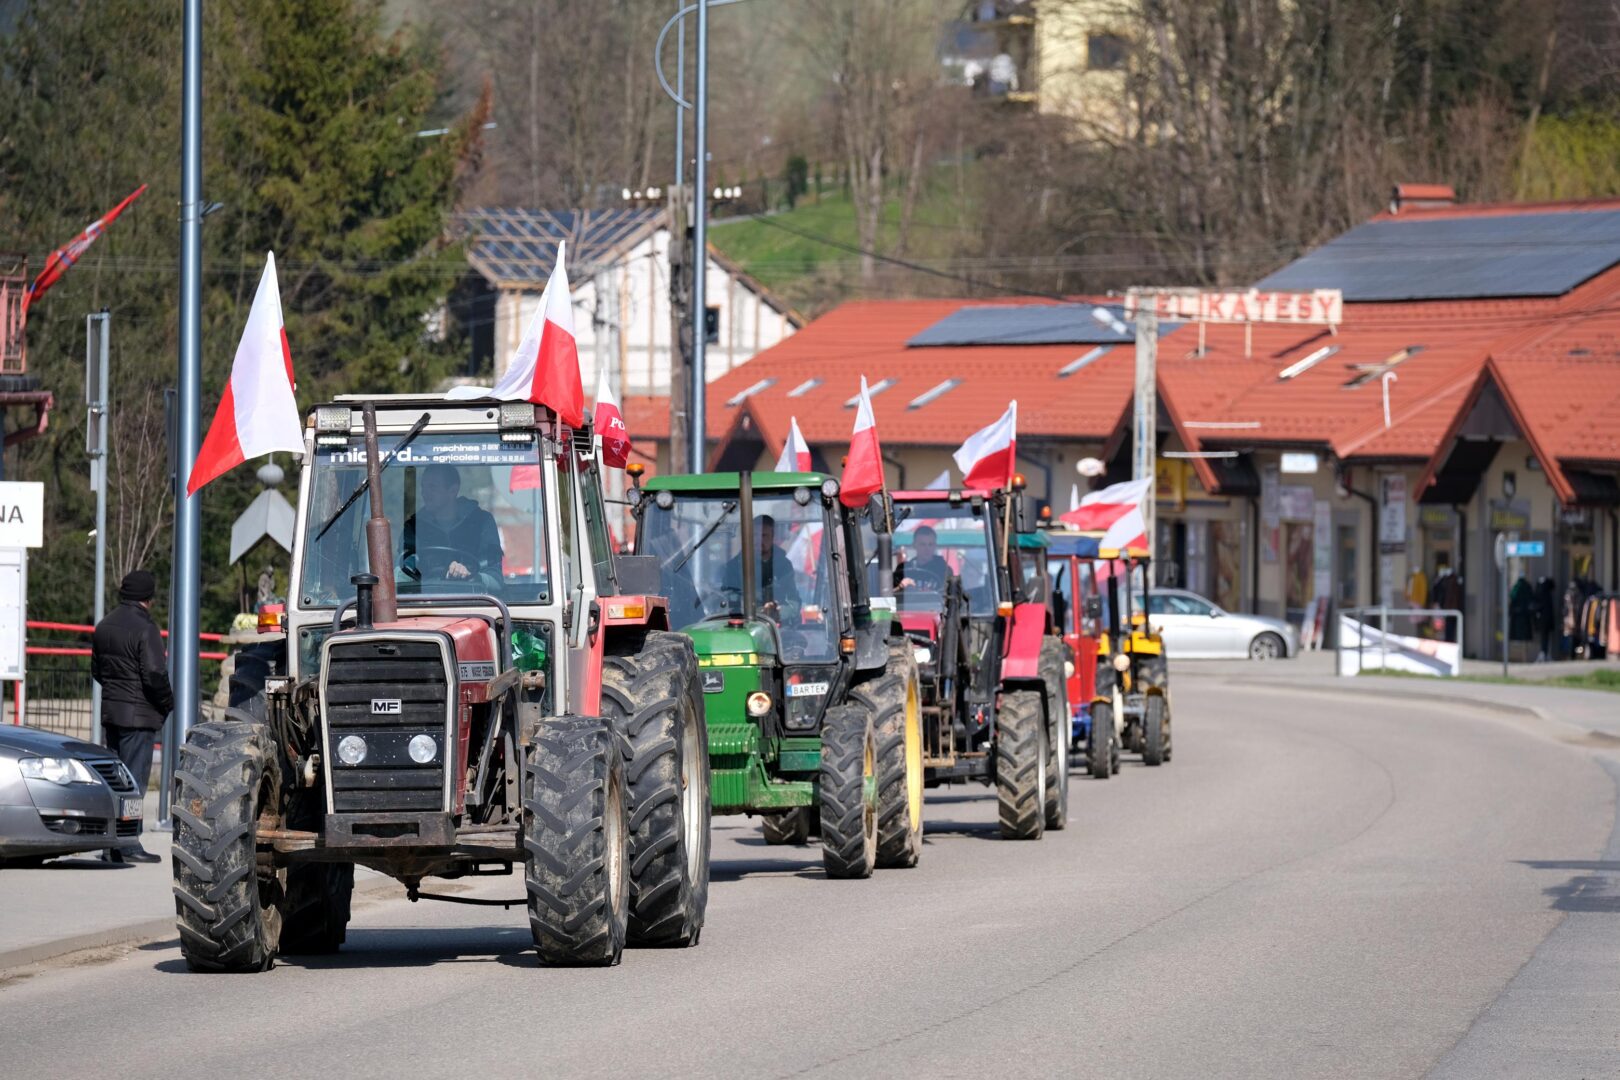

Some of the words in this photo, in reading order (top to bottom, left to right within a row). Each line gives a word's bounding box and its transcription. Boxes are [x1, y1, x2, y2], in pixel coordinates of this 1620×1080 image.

[433, 444, 480, 452] machines
[433, 453, 480, 463] agricoles
[793, 684, 826, 695] BARTEK
[373, 702, 399, 712] MF
